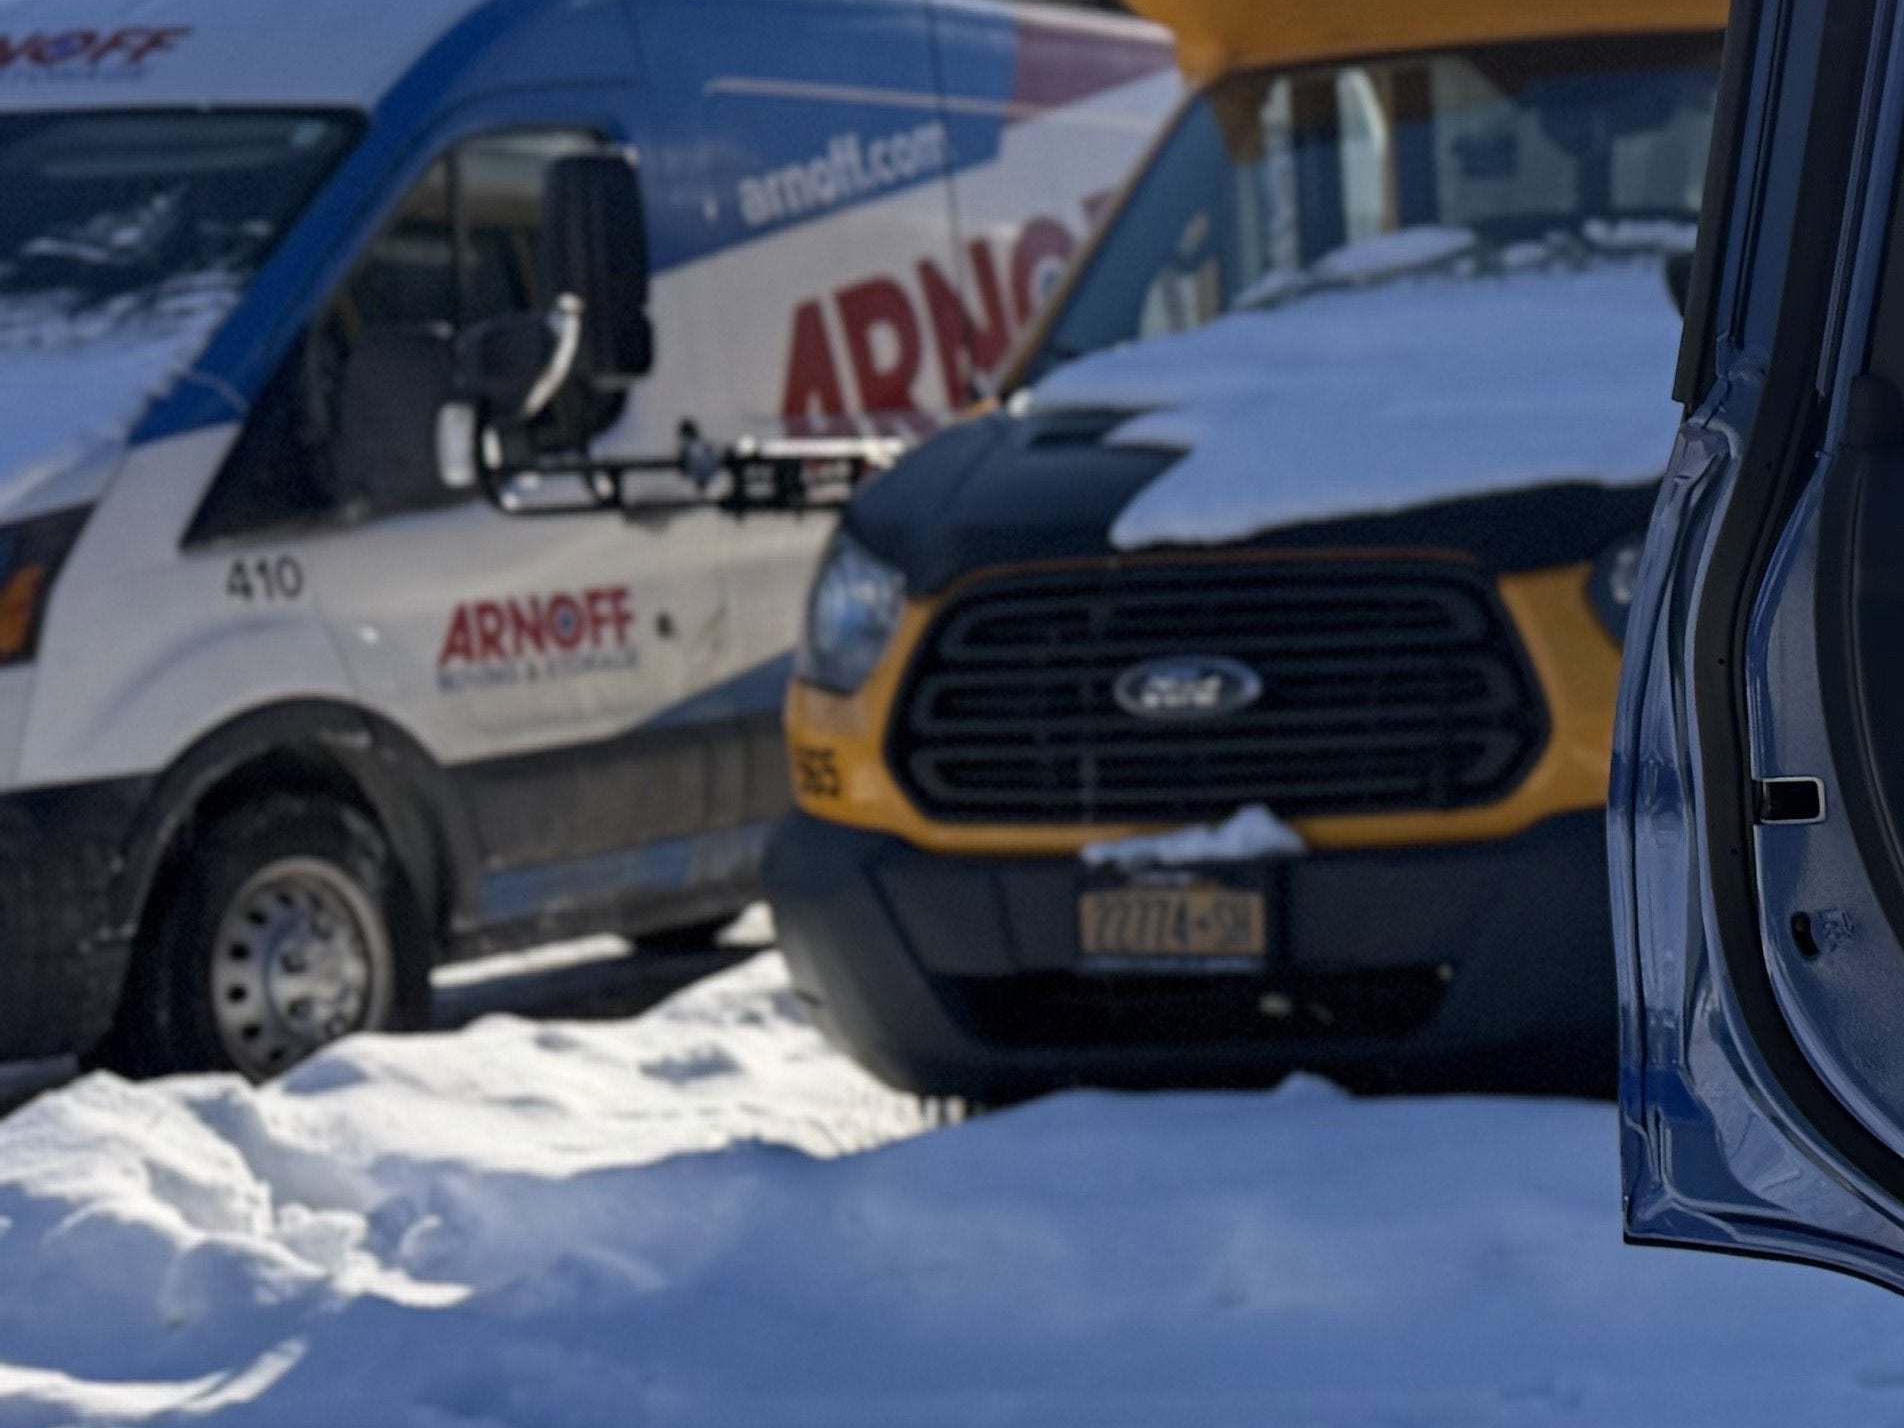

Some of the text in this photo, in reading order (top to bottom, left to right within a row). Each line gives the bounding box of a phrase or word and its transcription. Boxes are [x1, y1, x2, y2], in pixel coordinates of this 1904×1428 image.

[781, 189, 1119, 438] ARNO
[226, 556, 304, 600] 410
[438, 585, 634, 668] ARNOFF
